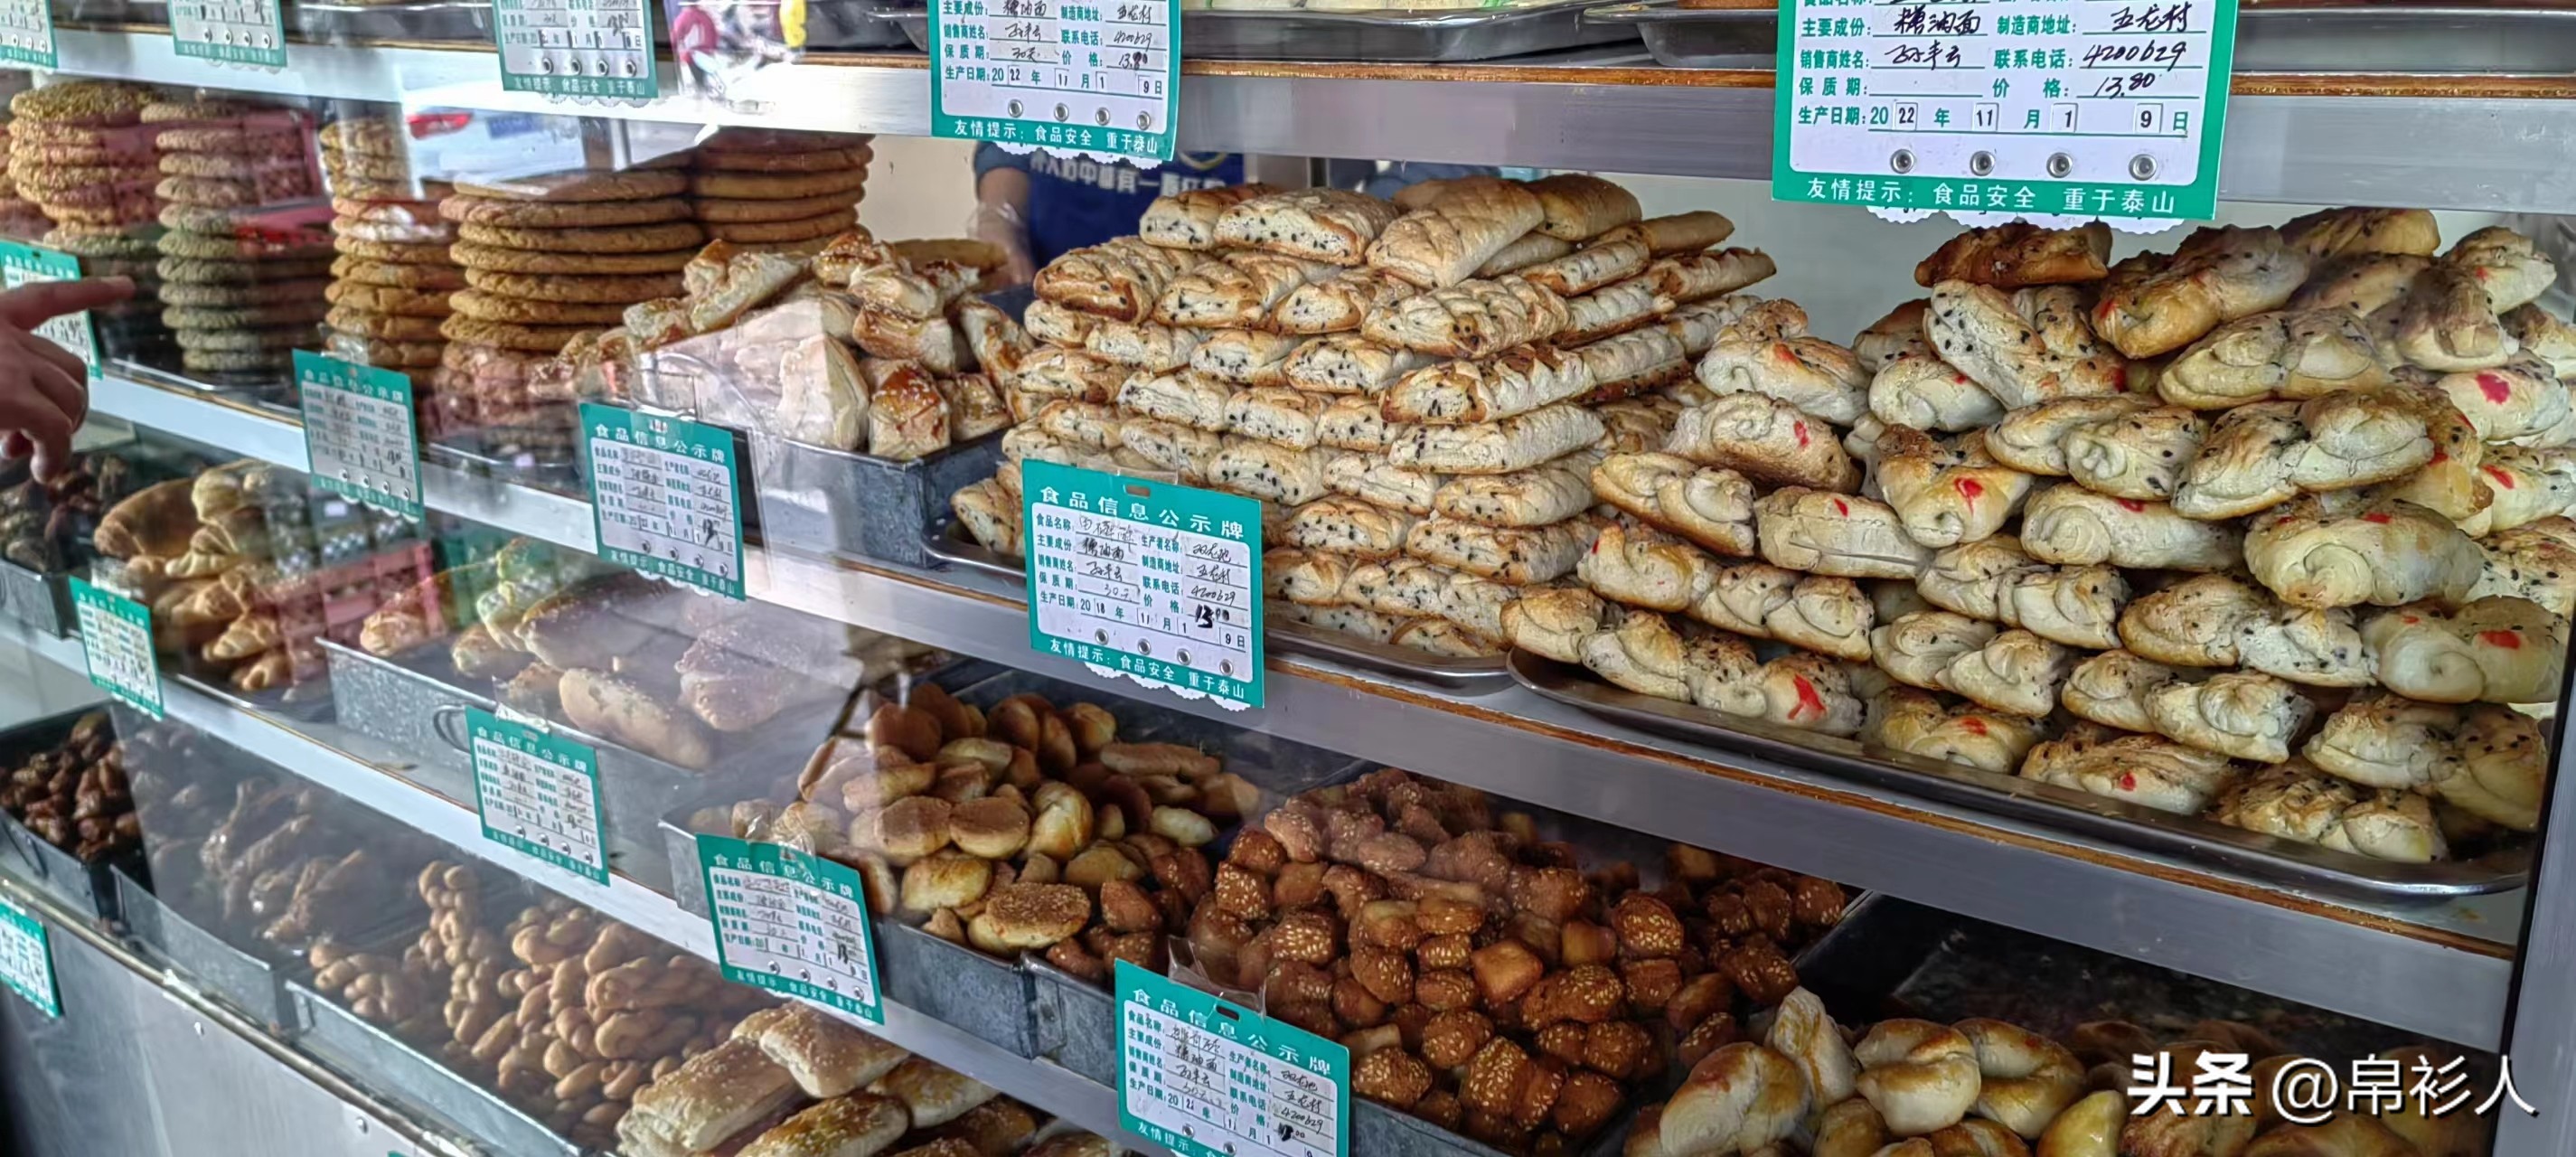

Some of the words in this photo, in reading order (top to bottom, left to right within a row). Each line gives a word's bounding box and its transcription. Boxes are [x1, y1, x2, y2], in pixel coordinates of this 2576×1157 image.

[1801, 17, 1871, 37] 主要成份:
[1997, 14, 2076, 35] 制造商地址:
[1800, 50, 1869, 69] 销售商姓名:
[1994, 48, 2073, 69] 联系电话:
[2083, 40, 2186, 71] 4200629
[1934, 108, 1951, 127] 年
[2024, 109, 2040, 129] 月
[2064, 110, 2073, 127] 1
[2140, 110, 2152, 128] 9
[2173, 111, 2188, 131] 日
[954, 119, 1024, 139] 友情提示:
[1035, 125, 1092, 146] 食品安全
[1106, 131, 1158, 154] 重于泰山
[1807, 177, 1913, 202] 友情提示:
[1933, 183, 2035, 208] 食品安全
[2063, 188, 2174, 213] 重于泰山
[1040, 486, 1244, 540] 食品信息公示牌
[1120, 654, 1175, 681] 食品安全
[1189, 671, 1245, 699] 重于泰山
[1133, 988, 1330, 1076] 食品信息公示牌
